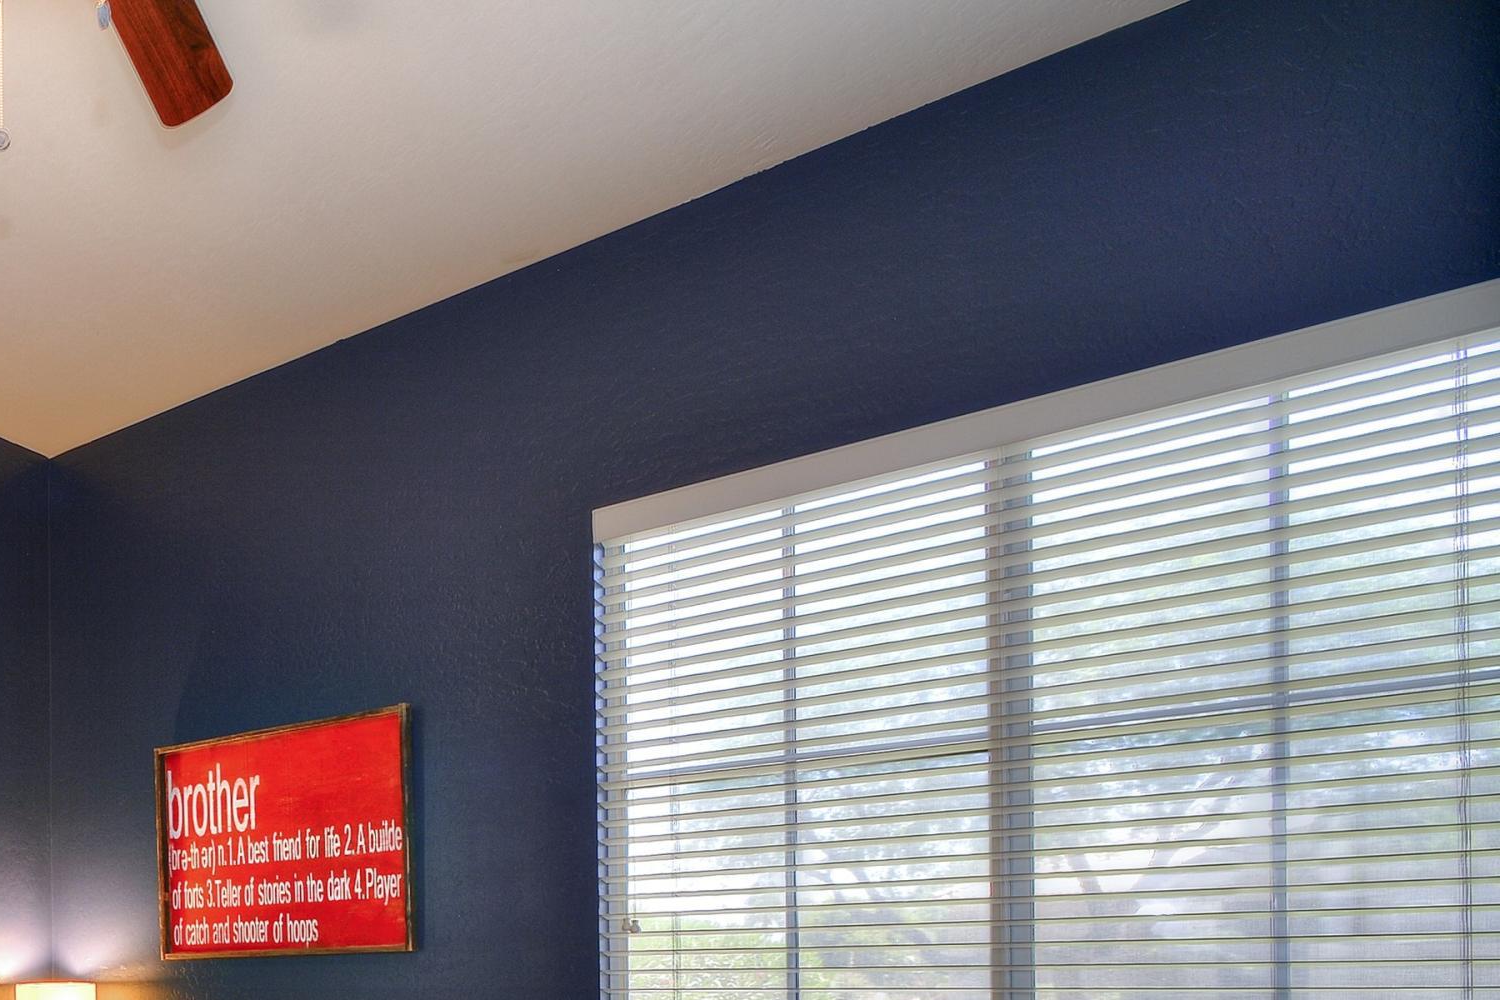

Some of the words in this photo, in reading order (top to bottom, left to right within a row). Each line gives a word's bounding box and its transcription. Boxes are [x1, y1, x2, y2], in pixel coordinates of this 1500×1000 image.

[167, 762, 260, 839] brother
[248, 835, 270, 864] best
[273, 829, 302, 861] friend
[306, 828, 321, 859] for
[324, 826, 341, 858] life
[368, 819, 403, 853] builde
[172, 881, 182, 910] of
[184, 880, 204, 909] forts
[244, 876, 255, 907] of
[258, 874, 291, 906] stories
[294, 873, 304, 903] in
[306, 872, 324, 903] the
[327, 869, 352, 902] dark
[174, 917, 183, 946] of
[185, 916, 210, 946] catch
[213, 915, 230, 945] and
[233, 914, 269, 944] shooter
[272, 912, 284, 944] of
[286, 912, 319, 949] hoops
